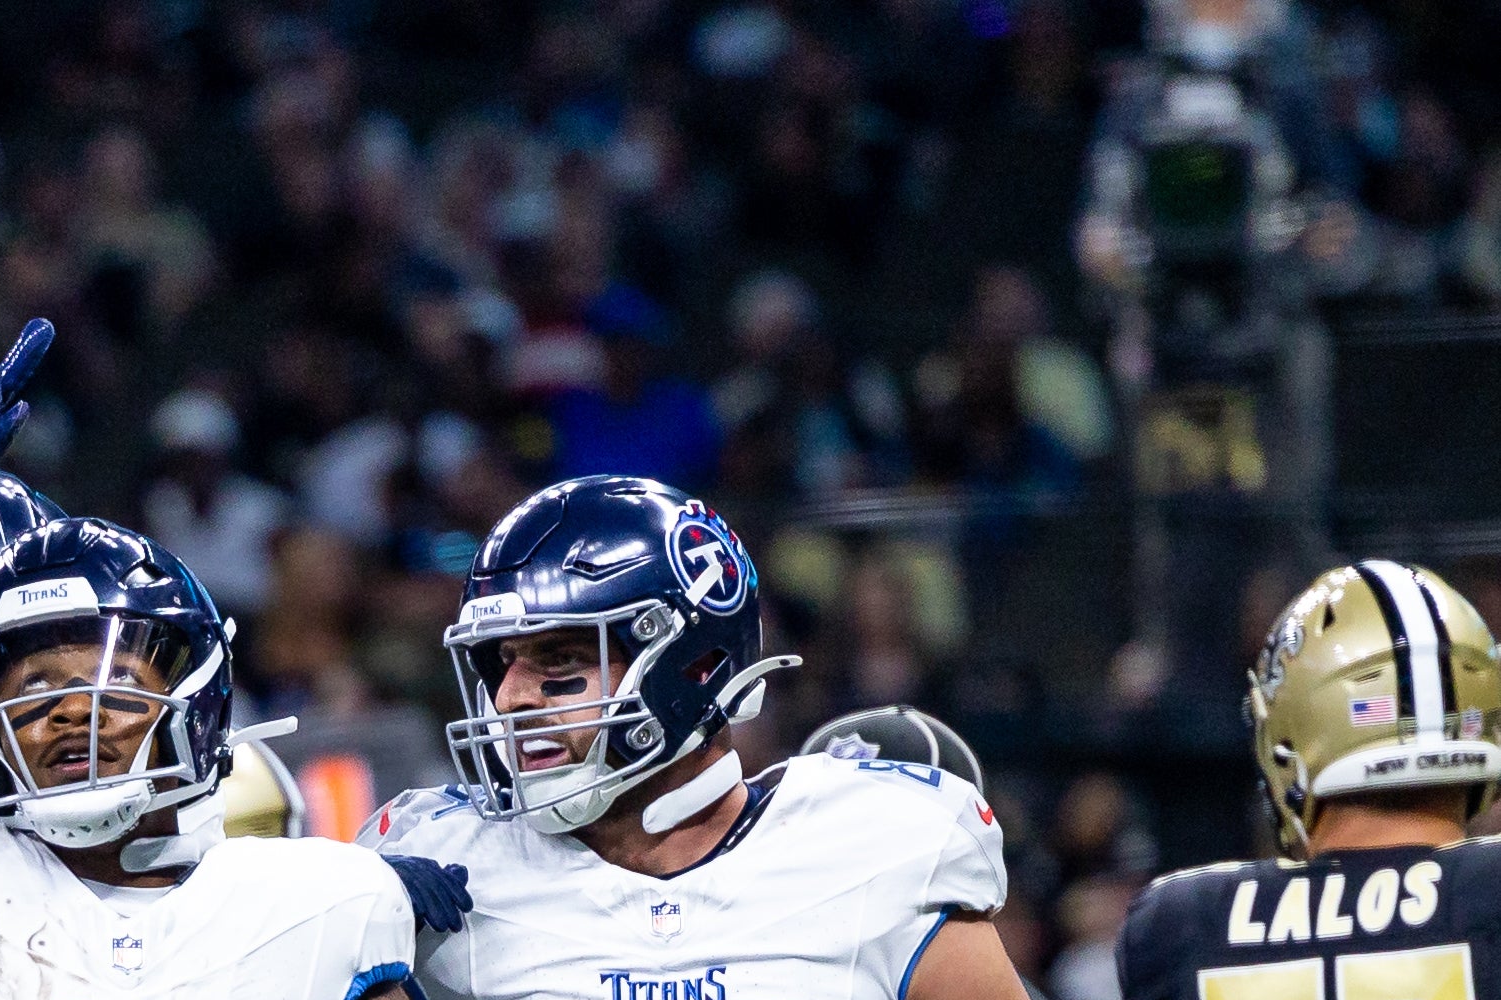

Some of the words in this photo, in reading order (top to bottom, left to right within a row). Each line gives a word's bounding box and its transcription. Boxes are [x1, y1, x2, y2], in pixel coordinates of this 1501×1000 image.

[18, 583, 67, 605] TITANS
[471, 600, 502, 620] TITANS
[1227, 860, 1442, 945] LALOS
